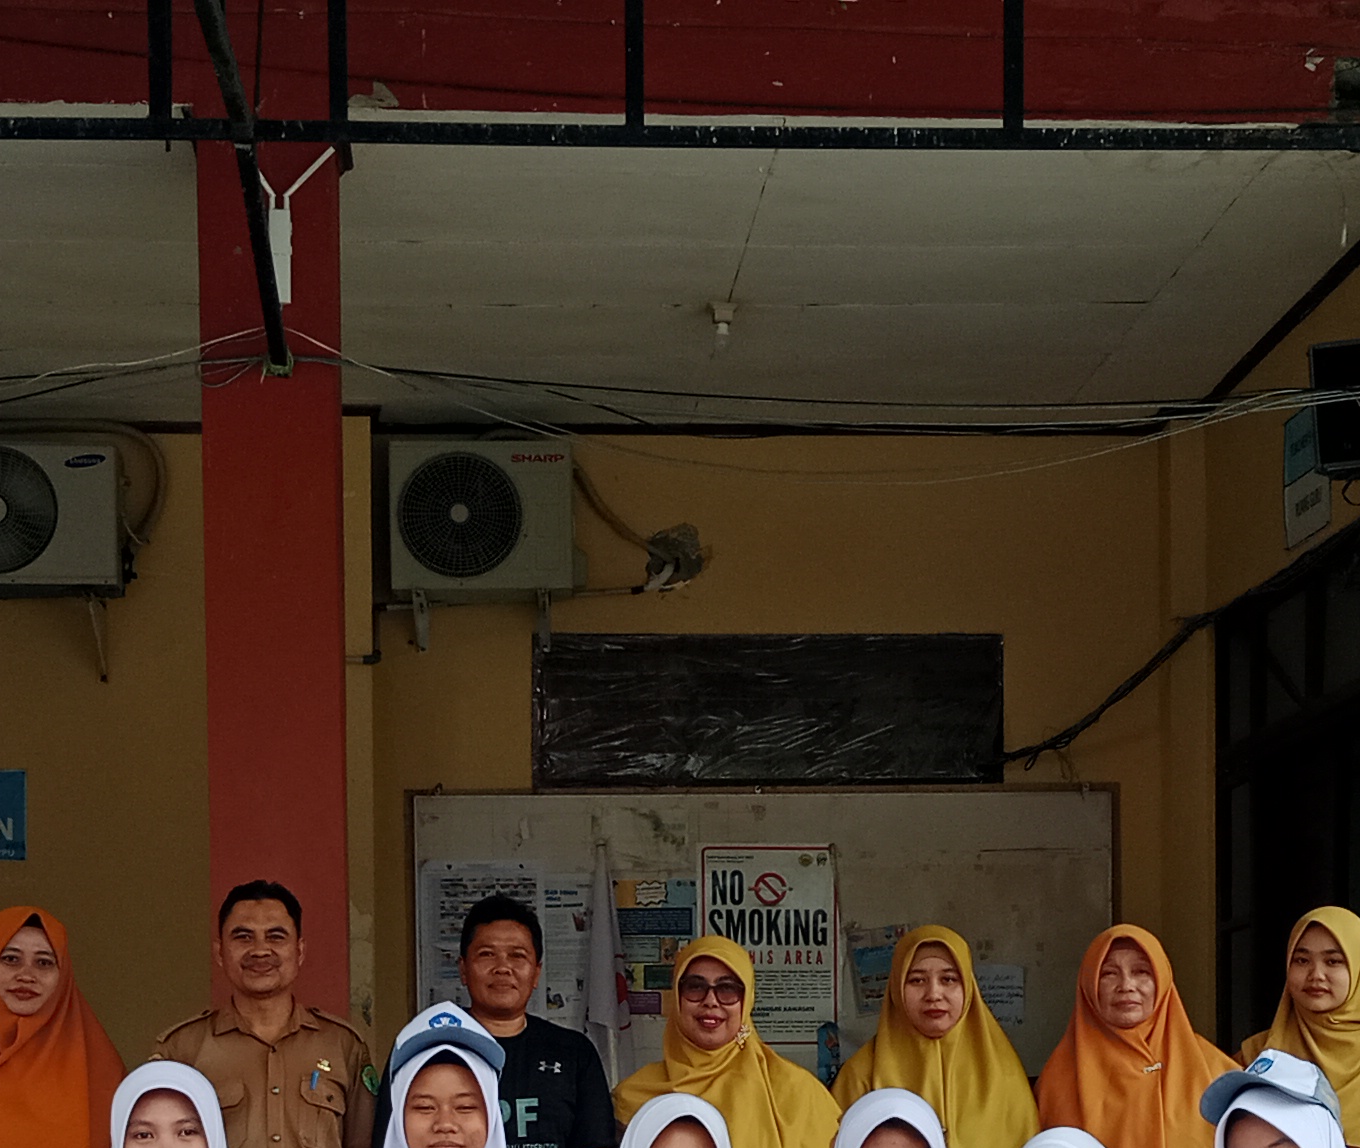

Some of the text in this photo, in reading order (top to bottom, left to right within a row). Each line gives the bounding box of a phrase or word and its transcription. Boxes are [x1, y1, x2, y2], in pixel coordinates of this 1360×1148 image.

[511, 454, 565, 463] SHARP
[711, 870, 744, 905] NO
[709, 909, 828, 946] SMOKING
[749, 950, 823, 965] HIS AREA
